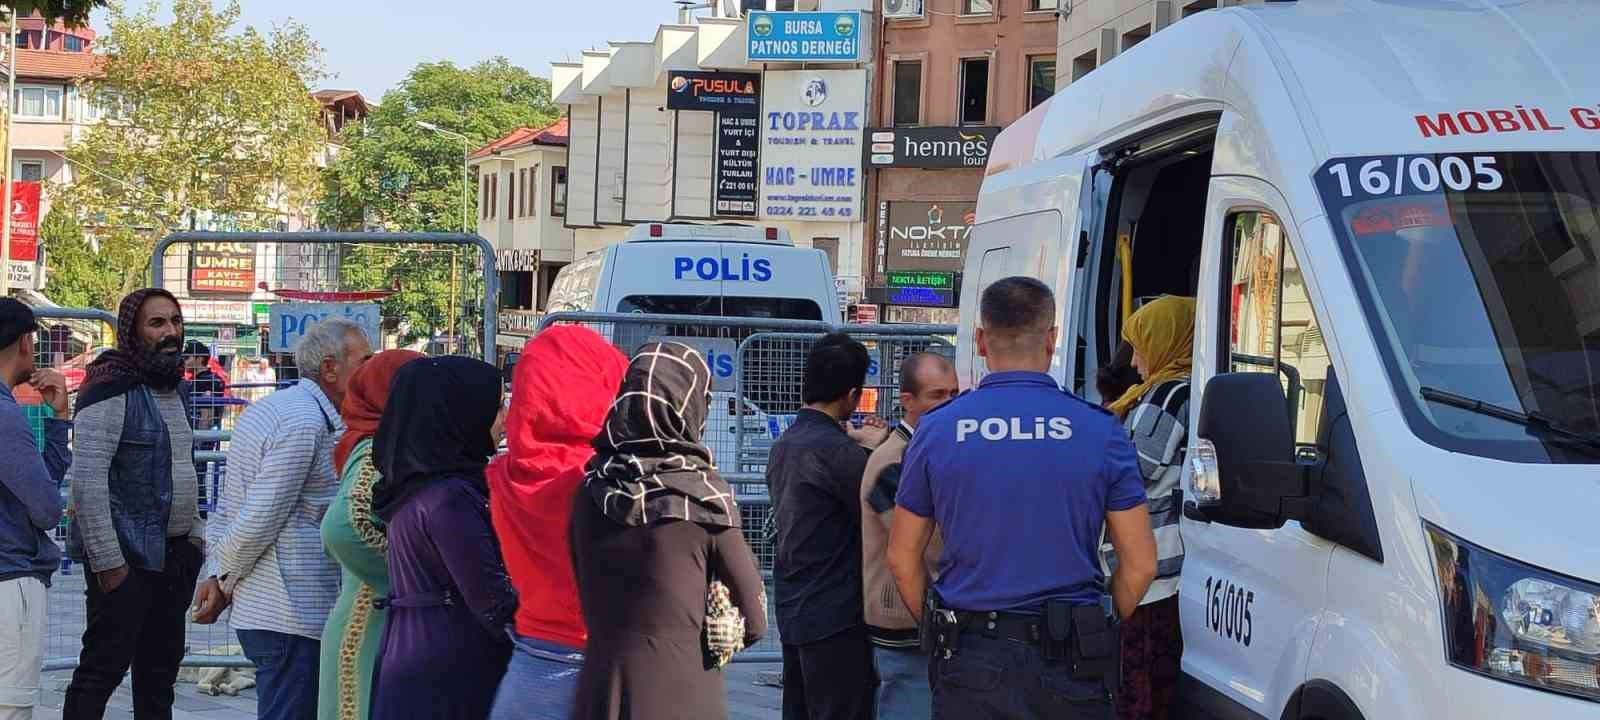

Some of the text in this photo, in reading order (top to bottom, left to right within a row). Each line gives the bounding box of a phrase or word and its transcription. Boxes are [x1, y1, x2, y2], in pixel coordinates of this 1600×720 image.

[784, 20, 823, 34] BURSA
[751, 38, 856, 55] PATNOS DERNEĞİ
[692, 79, 754, 96] PUSULA
[768, 112, 858, 130] TOPRAK
[1415, 105, 1566, 137] MOBİL
[723, 129, 743, 137] YURT
[822, 137, 855, 145] TRAVEL
[723, 159, 752, 167] KÜLTÜR
[721, 170, 752, 178] TURLARI
[766, 167, 795, 185] HAC
[811, 167, 855, 186] UMRE
[1328, 156, 1503, 197] 16/005
[726, 182, 737, 190] 221
[766, 206, 793, 216] 0224
[798, 207, 817, 216] 221
[196, 256, 252, 270] UMRE
[674, 253, 772, 282] POLİS
[1205, 576, 1254, 647] 16/005
